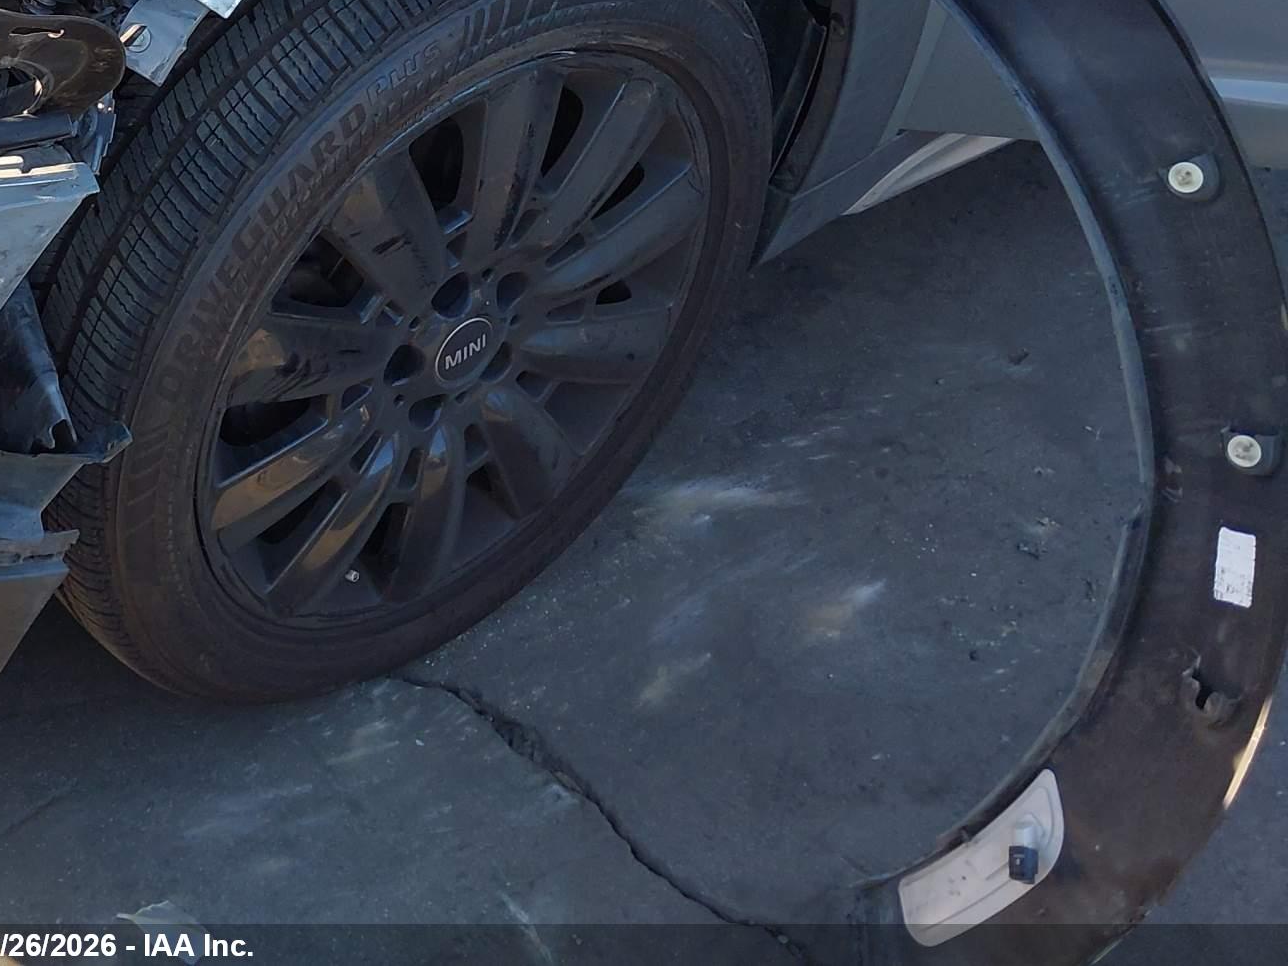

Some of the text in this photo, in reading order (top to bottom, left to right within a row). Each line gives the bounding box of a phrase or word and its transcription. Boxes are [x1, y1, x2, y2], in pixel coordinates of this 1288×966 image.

[156, 40, 440, 402] DRIVEGUARD PLUS
[445, 334, 486, 370] MINI
